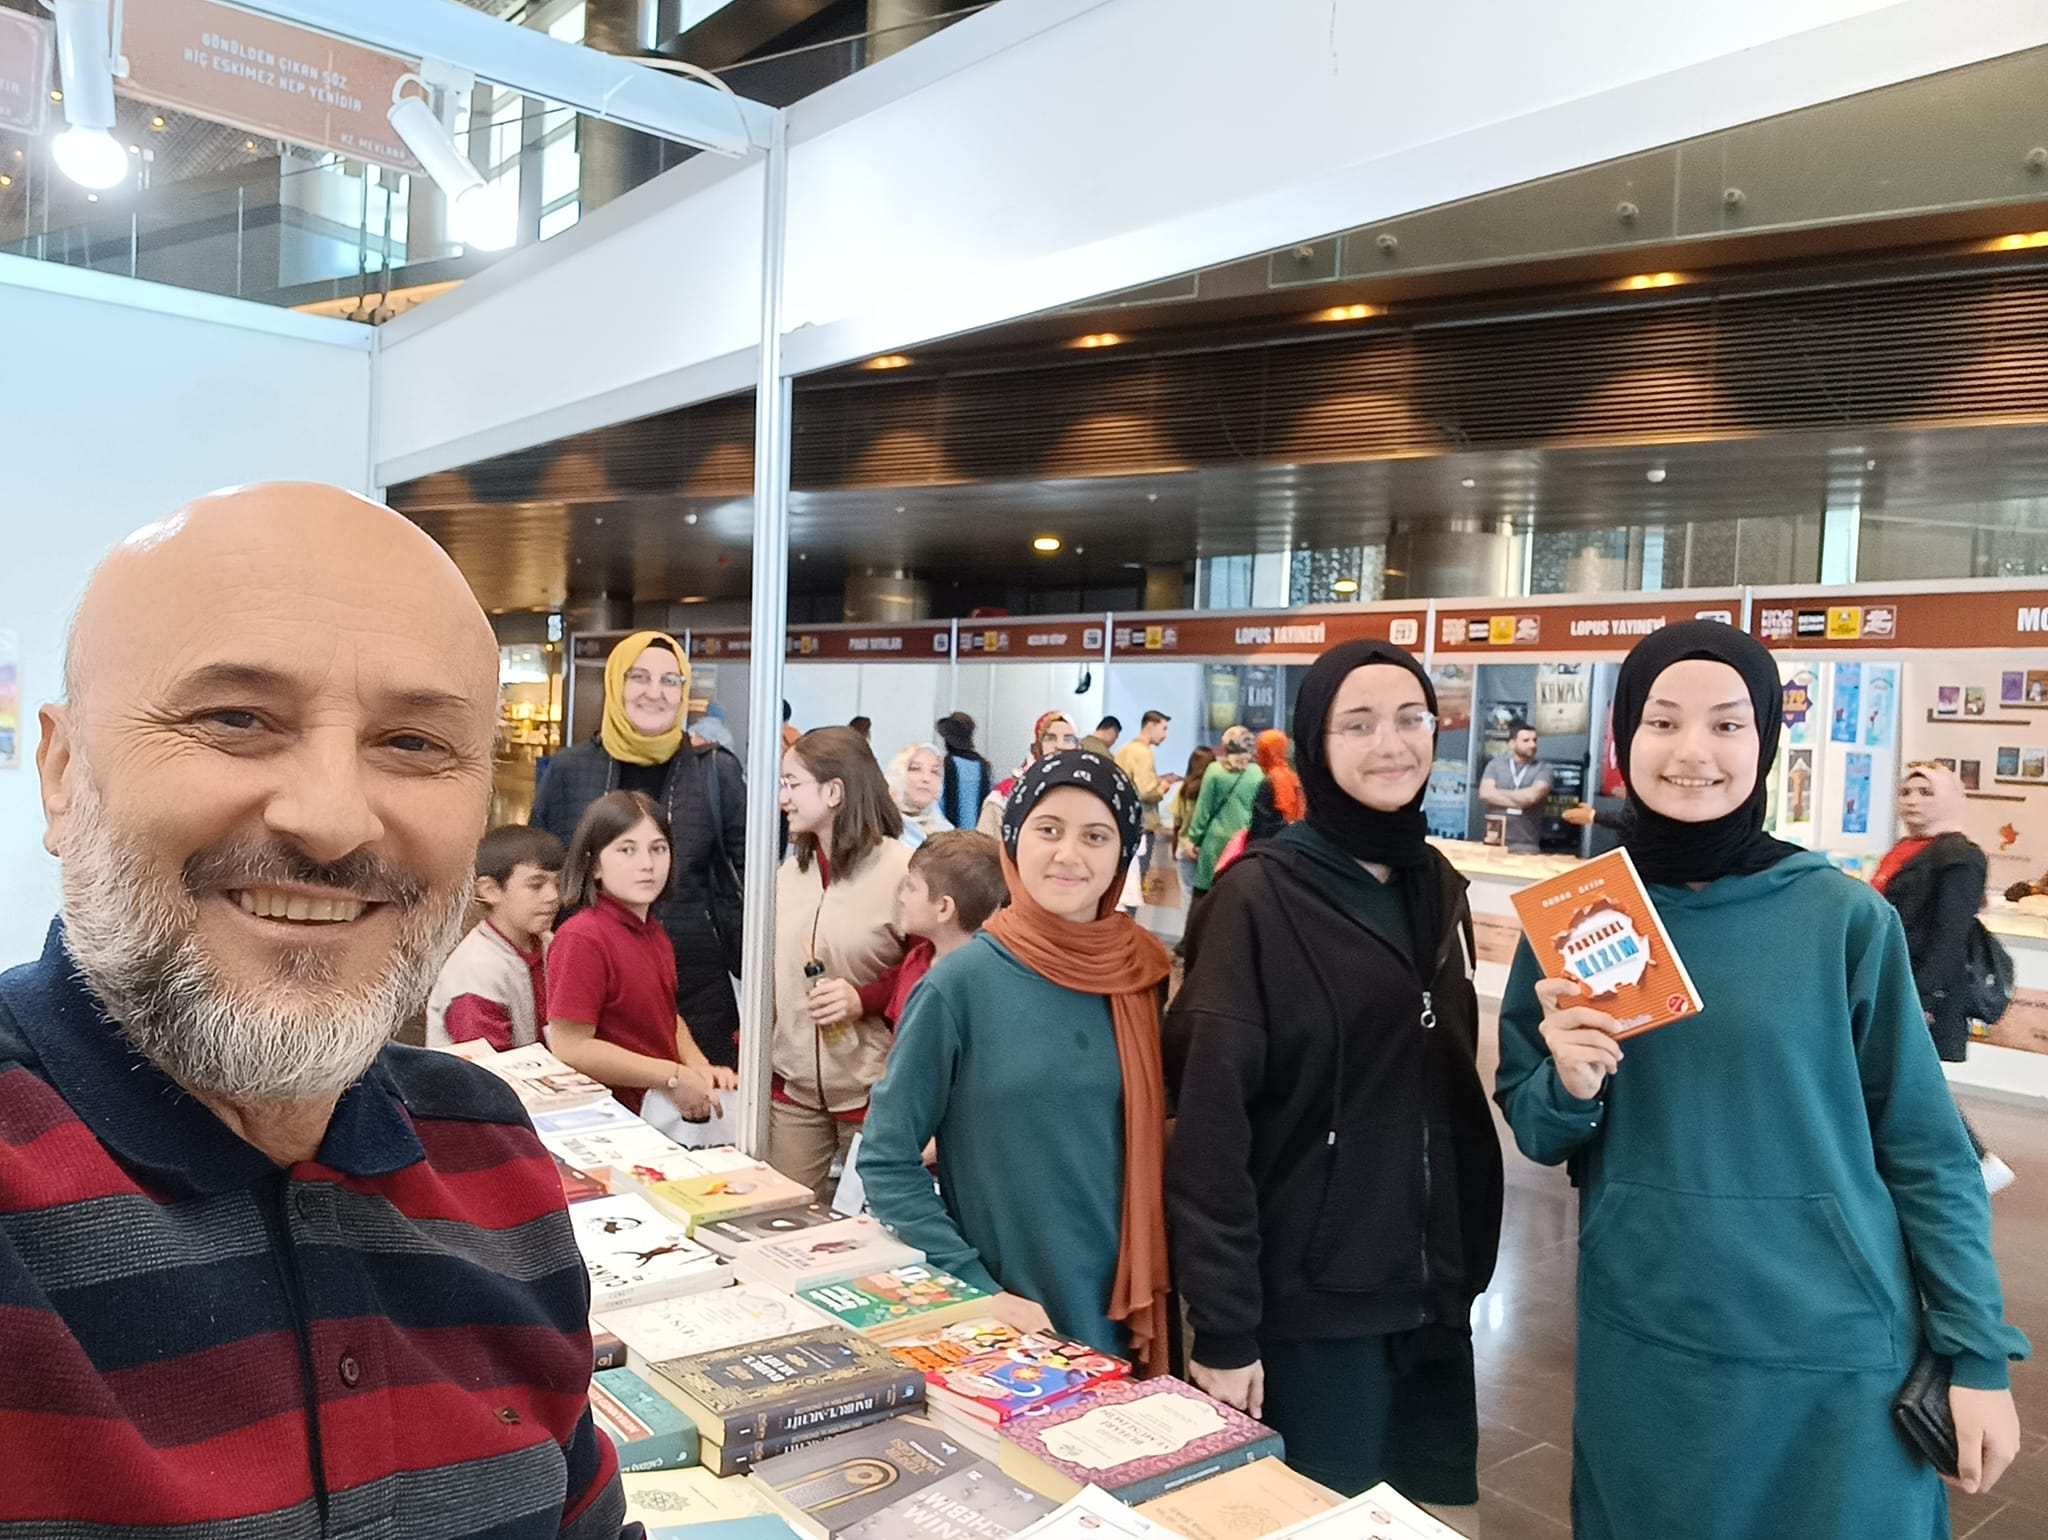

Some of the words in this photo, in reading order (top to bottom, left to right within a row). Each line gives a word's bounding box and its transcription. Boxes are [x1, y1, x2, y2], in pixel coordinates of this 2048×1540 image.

[202, 33, 275, 66] GÖNÜLDEN
[279, 56, 318, 80] ÇIKAN
[184, 48, 208, 67] HİÇ
[213, 56, 275, 86] ESKİMEZ
[279, 77, 305, 94] HEP
[310, 85, 362, 112] YENİDİR
[1235, 627, 1271, 645] LOPUS
[1570, 619, 1609, 637] LOPUS
[1567, 921, 1624, 955] PORTAKAL
[1575, 935, 1639, 979] KIZIM
